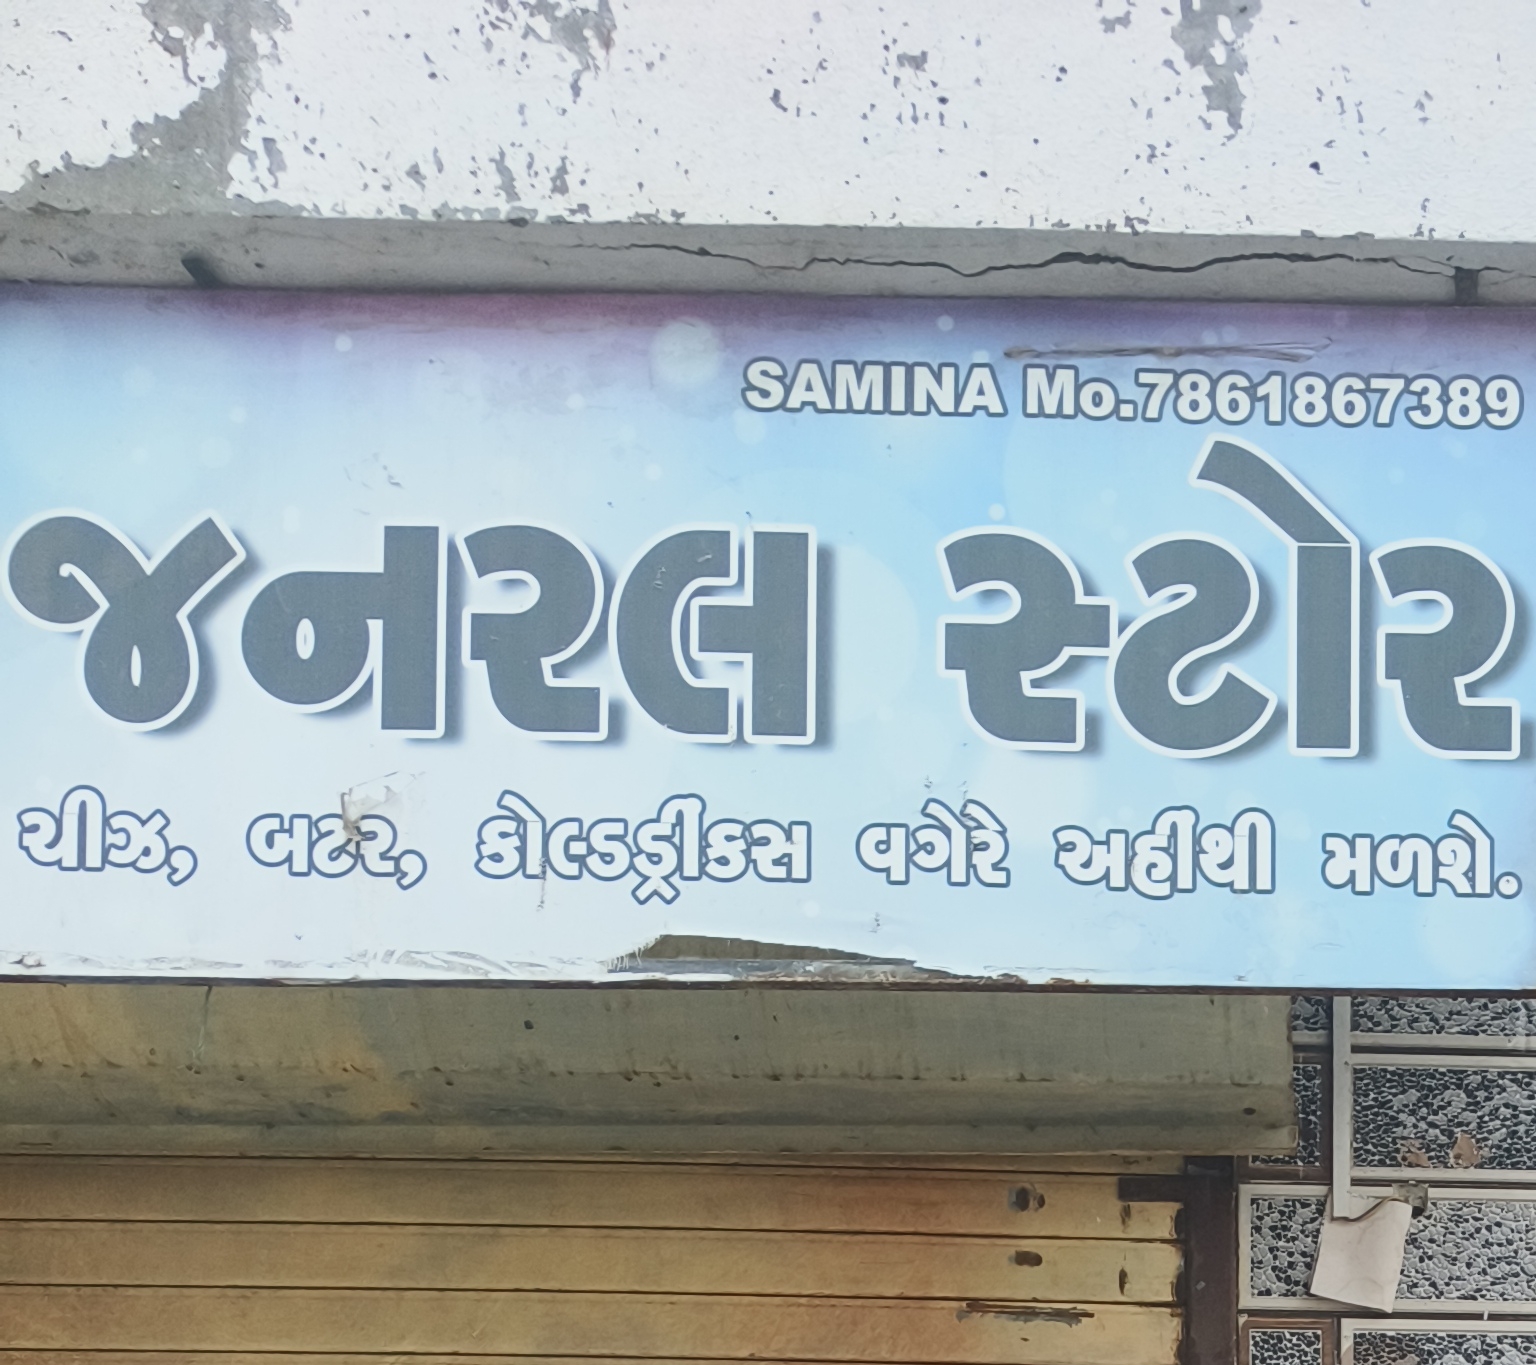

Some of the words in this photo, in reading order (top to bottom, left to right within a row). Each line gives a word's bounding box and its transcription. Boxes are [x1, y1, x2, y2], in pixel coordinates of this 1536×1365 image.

[743, 358, 1005, 418] SAMINA
[1021, 364, 1524, 430] Mo.7861867389
[6, 508, 822, 748] જનરલ
[938, 434, 1524, 762] સ્ટોર
[16, 784, 198, 887] ચીઝ,
[245, 812, 428, 891] બટર,
[855, 797, 1011, 888] વગેરે
[1321, 808, 1523, 900] મળશે.
